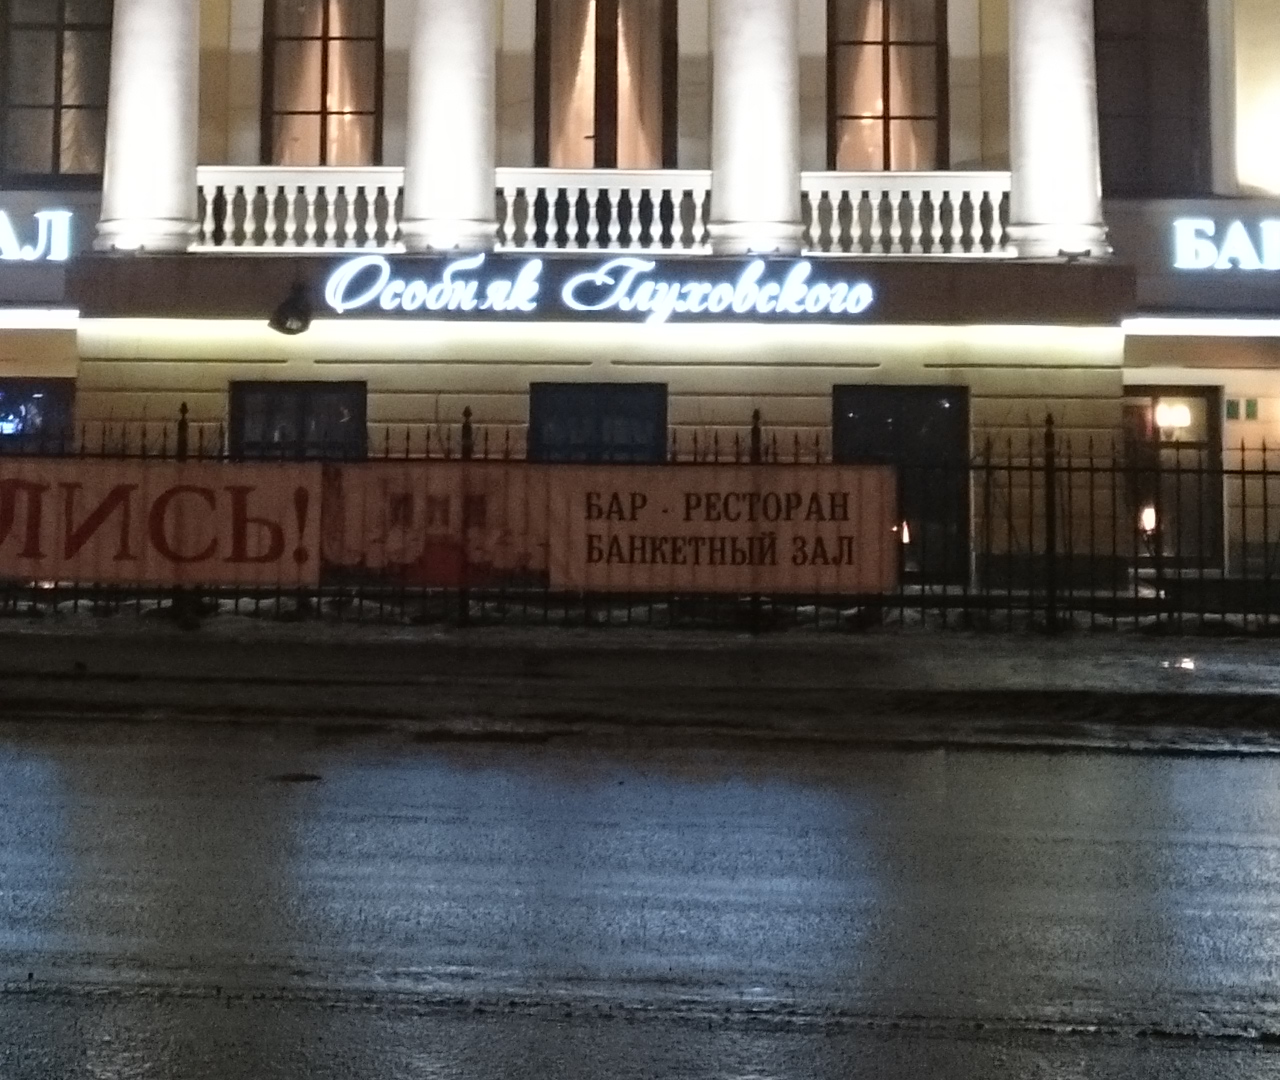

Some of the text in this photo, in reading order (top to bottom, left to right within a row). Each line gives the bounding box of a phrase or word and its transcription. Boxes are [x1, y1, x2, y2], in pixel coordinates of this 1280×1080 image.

[324, 253, 874, 324] Особняк Глуховского
[585, 491, 852, 522] БАР РЕСТОРАН
[586, 530, 855, 566] БАНКЕТНЫЙ ЗАЛ
